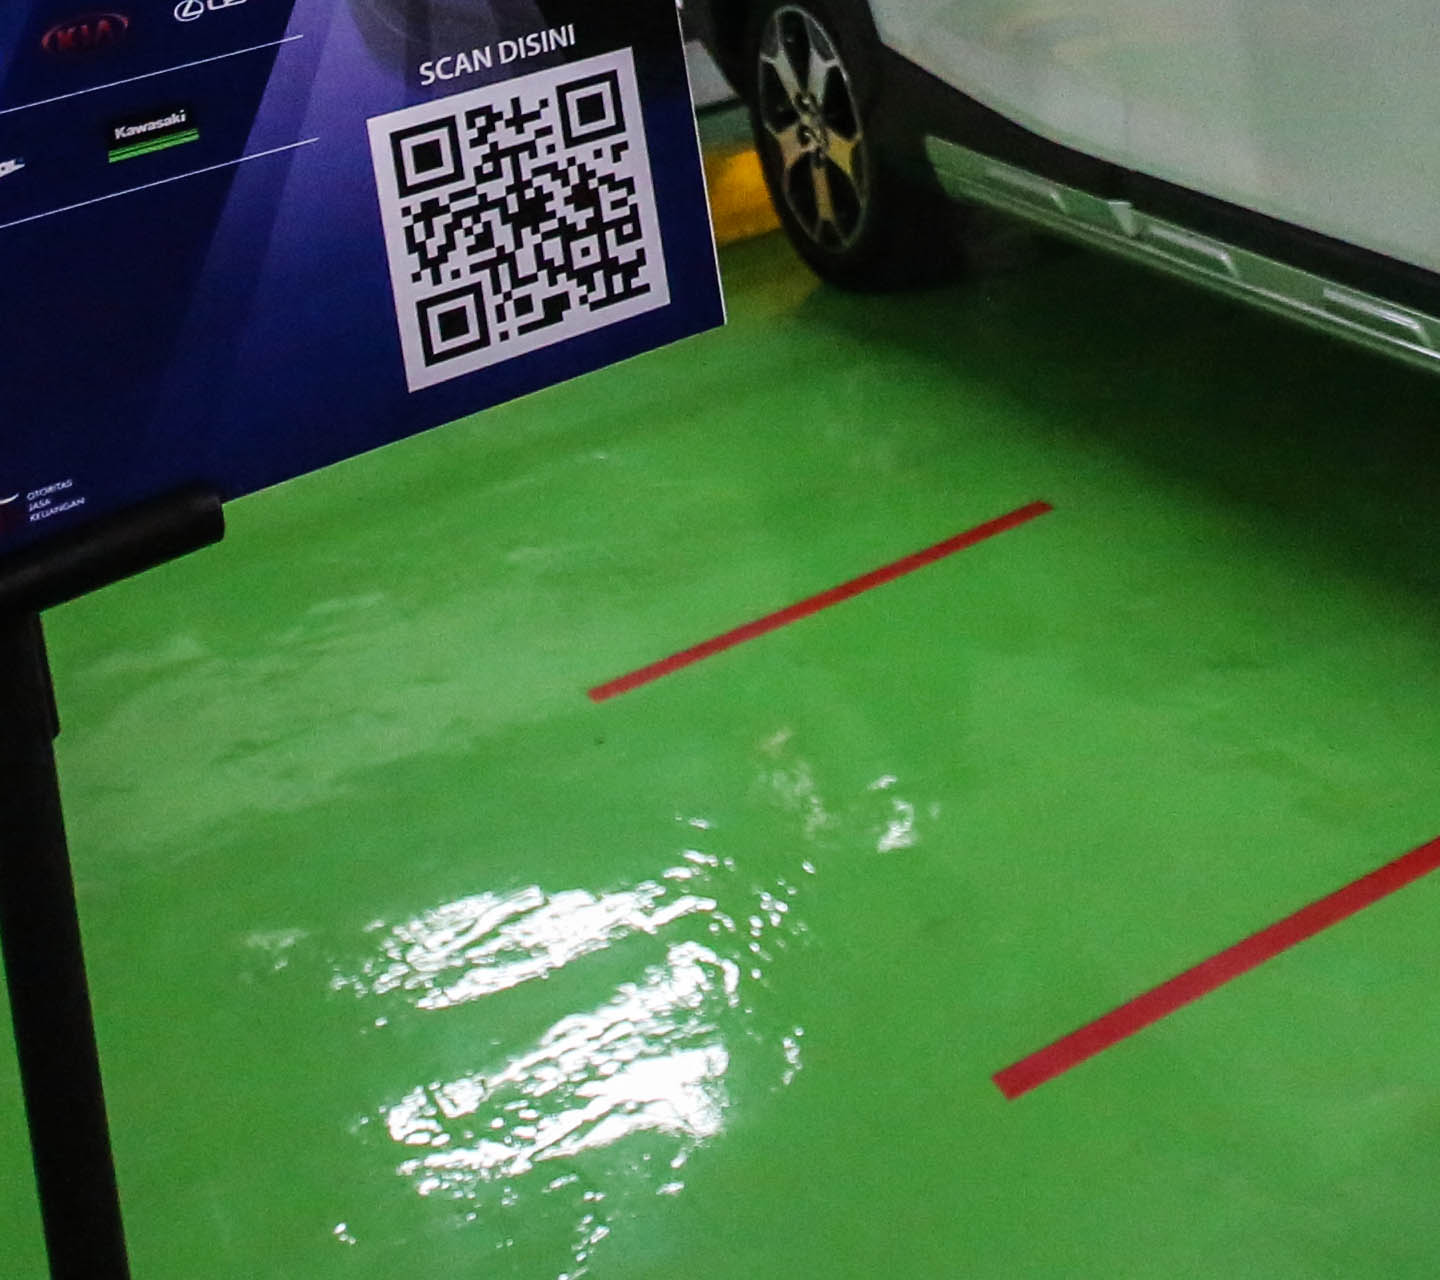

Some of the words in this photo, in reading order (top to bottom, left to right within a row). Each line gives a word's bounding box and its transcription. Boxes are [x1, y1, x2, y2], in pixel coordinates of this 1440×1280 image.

[418, 44, 493, 86] SCAN
[496, 22, 576, 64] DISINI
[113, 109, 187, 140] Kawasaki
